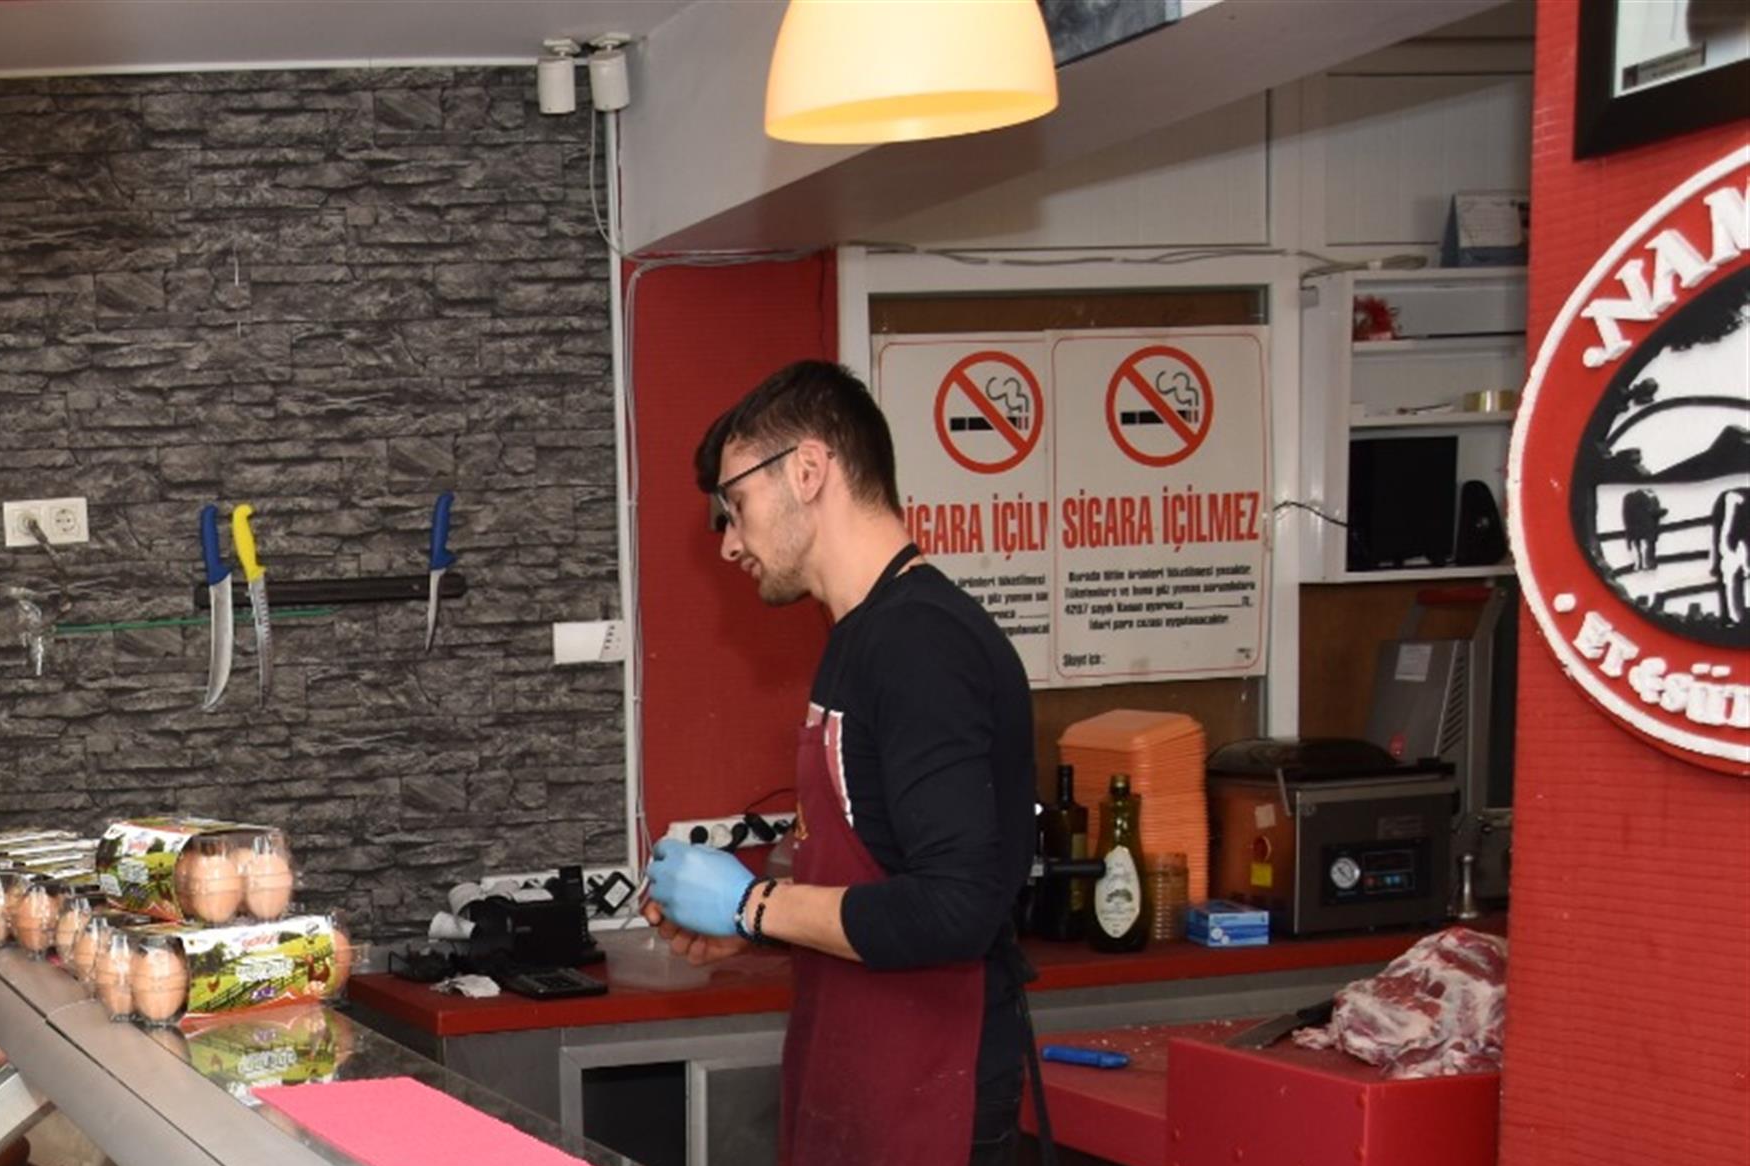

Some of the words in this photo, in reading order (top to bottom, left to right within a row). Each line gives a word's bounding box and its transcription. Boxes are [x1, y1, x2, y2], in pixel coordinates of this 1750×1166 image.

[903, 495, 985, 556] İGARA
[1062, 488, 1153, 549] SİGARA
[1162, 484, 1259, 553] İÇİLMEZ
[1573, 611, 1639, 677] ET
